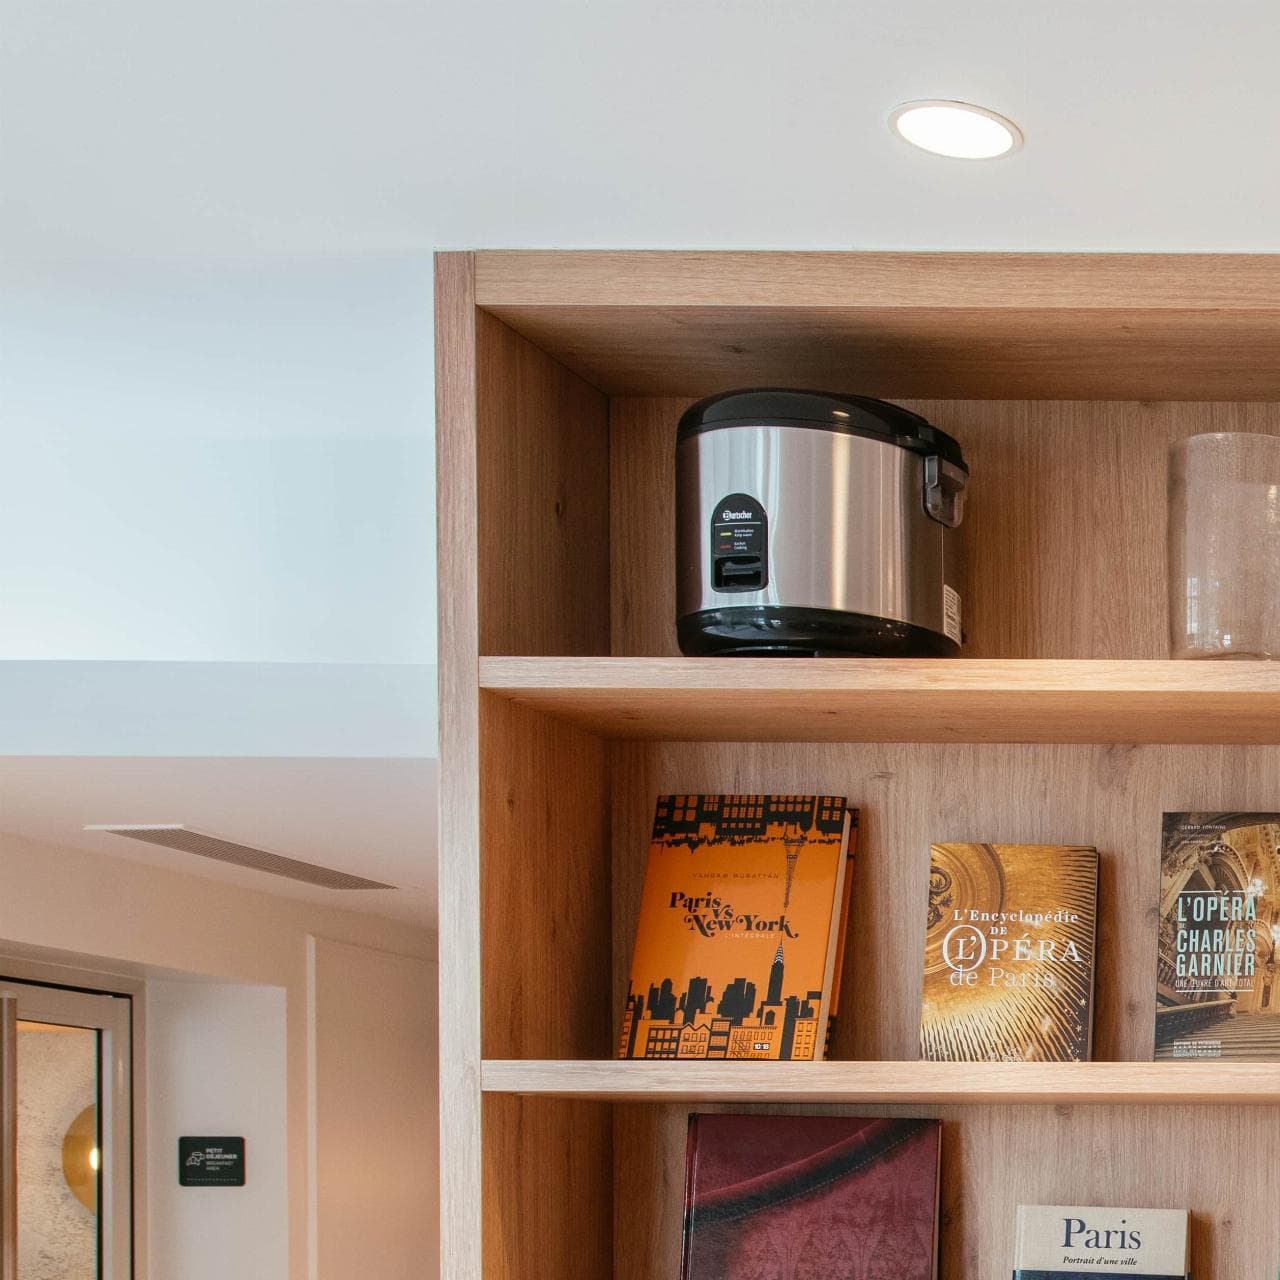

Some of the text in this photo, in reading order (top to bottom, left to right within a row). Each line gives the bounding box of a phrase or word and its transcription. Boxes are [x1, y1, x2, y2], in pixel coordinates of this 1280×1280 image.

[669, 891, 721, 913] Paris
[712, 904, 733, 919] vs
[1178, 890, 1257, 922] L'OPÉRA
[684, 914, 799, 938] New York
[953, 909, 1079, 925] L'Encyclopédie
[990, 926, 1008, 935] DE
[1177, 929, 1256, 953] CHARLES
[950, 965, 1055, 987] de Paris
[1176, 953, 1255, 977] GARNIER
[1061, 1218, 1142, 1249] Paris
[1063, 1256, 1094, 1264] Portrait
[1096, 1257, 1118, 1265] d'une
